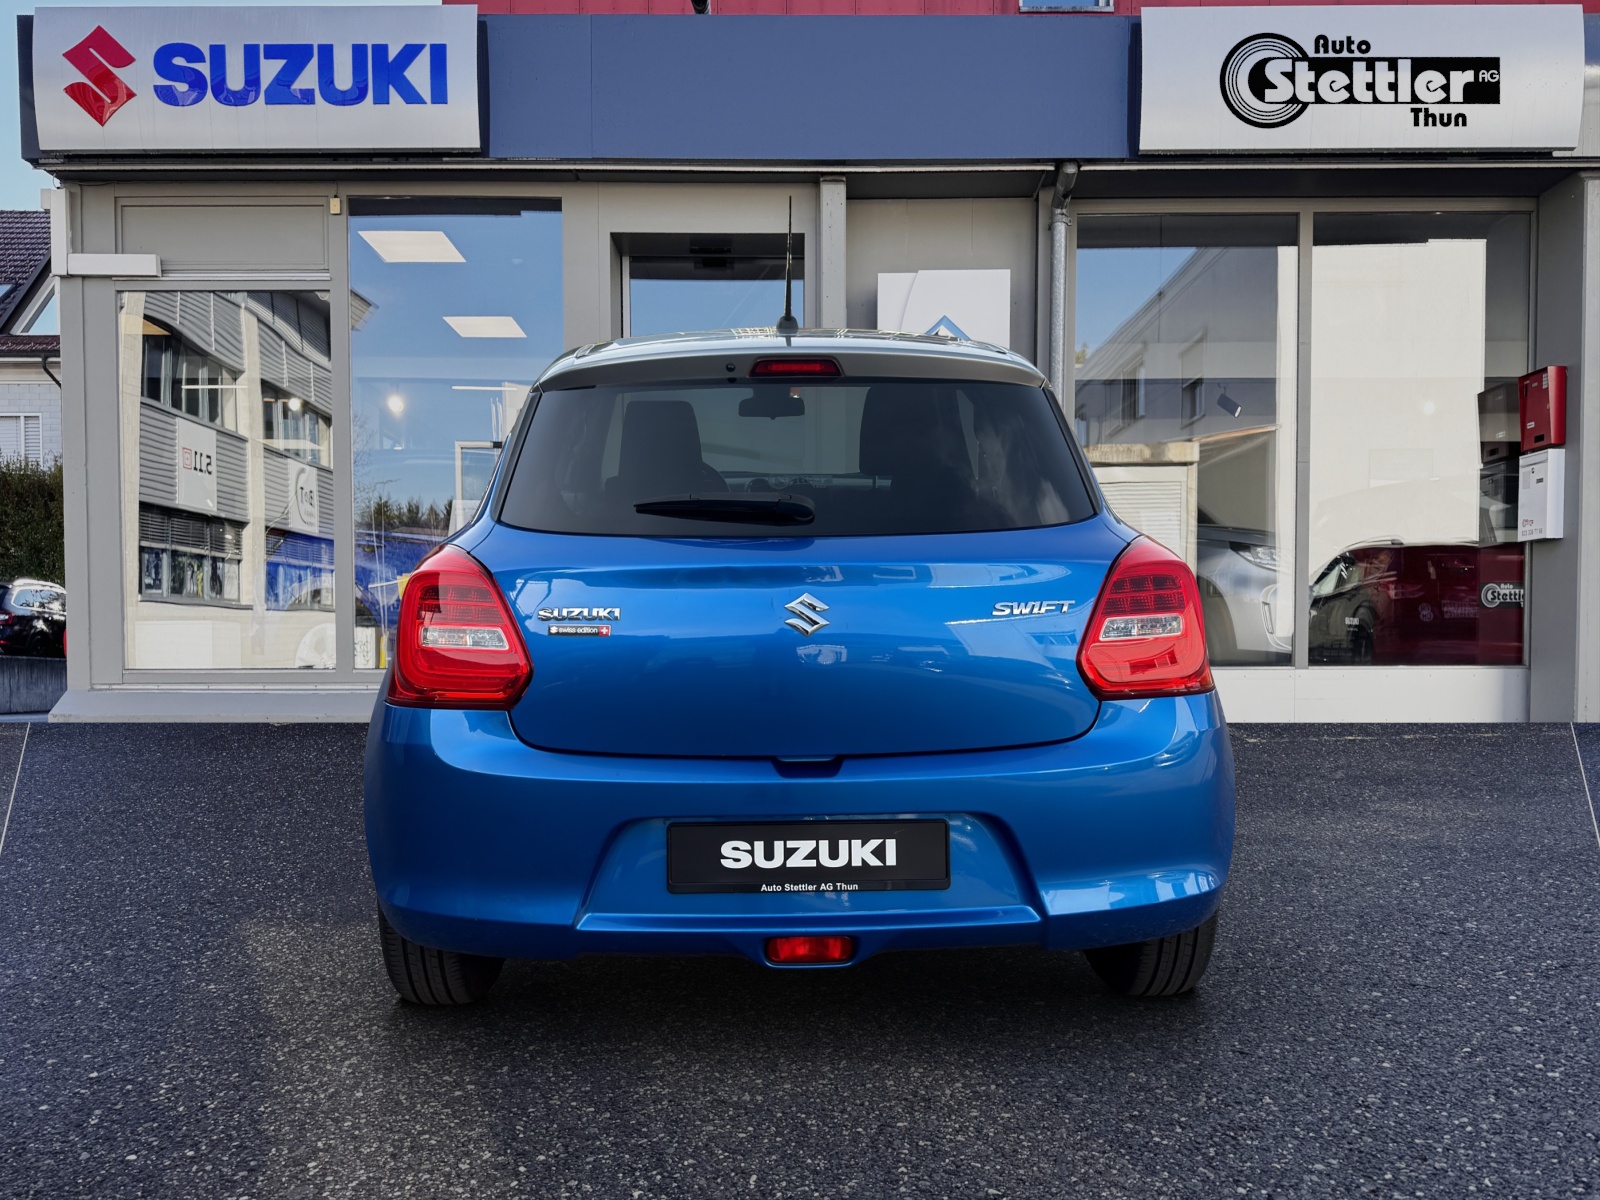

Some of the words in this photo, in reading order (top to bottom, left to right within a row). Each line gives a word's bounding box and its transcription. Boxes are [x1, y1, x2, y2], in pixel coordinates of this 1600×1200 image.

[1314, 34, 1371, 55] Auto
[153, 42, 448, 106] SUZUKI
[1264, 58, 1475, 104] Stettler
[1479, 70, 1500, 82] AG
[1410, 107, 1468, 128] Thun
[538, 607, 620, 621] SUZUKI
[992, 600, 1076, 616] SWIFT
[558, 626, 576, 634] swiss
[577, 626, 598, 634] edition
[720, 838, 897, 869] SUZUKI
[760, 884, 782, 892] Auto
[784, 883, 817, 892] Stettler
[820, 882, 834, 891] AG
[836, 882, 859, 891] Thun
